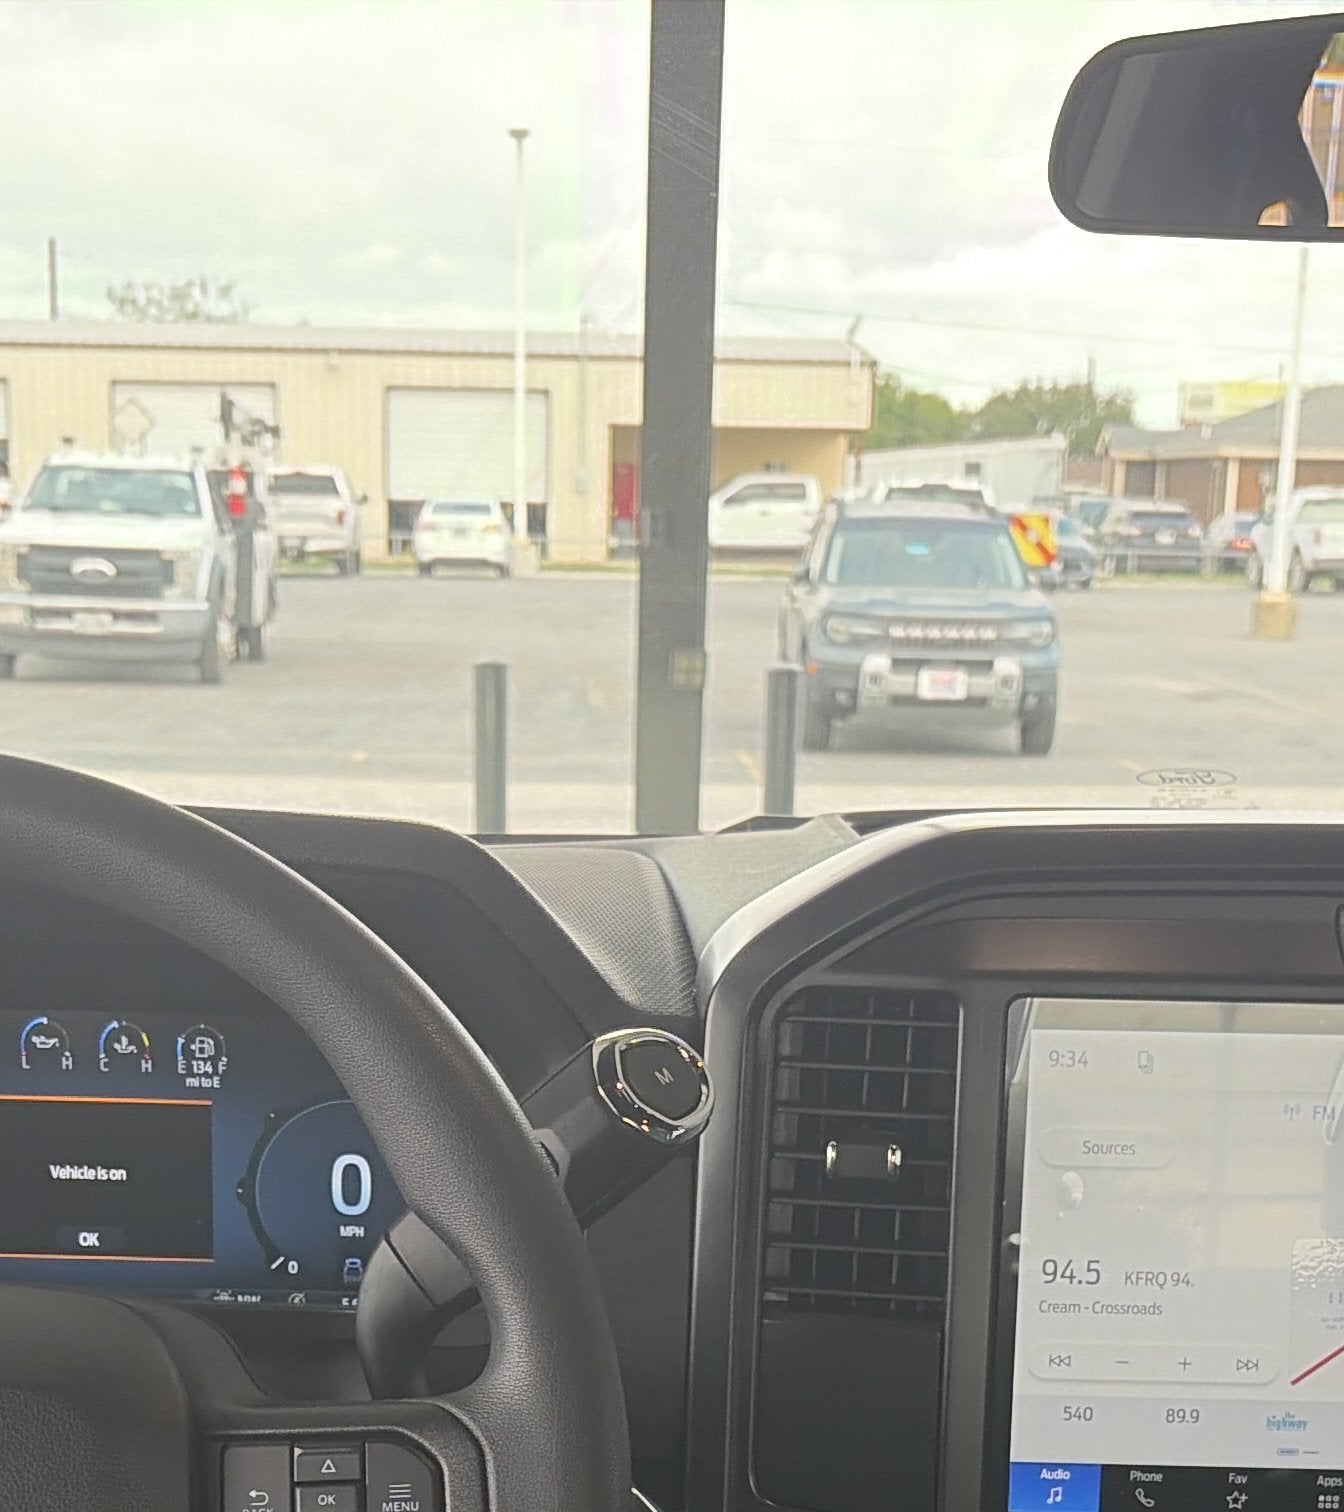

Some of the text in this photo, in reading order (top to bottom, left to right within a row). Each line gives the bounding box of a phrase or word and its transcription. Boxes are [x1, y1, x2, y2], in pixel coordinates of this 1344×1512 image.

[22, 1056, 31, 1070] L
[61, 1056, 73, 1070] H
[99, 1059, 110, 1072] C
[1048, 1049, 1089, 1068] 9:34
[141, 1060, 153, 1073] H
[177, 1060, 187, 1074] E
[192, 1060, 213, 1074] 134
[654, 1067, 675, 1086] M
[1312, 1104, 1336, 1122] FM
[1082, 1140, 1136, 1156] Sources
[49, 1164, 127, 1181] Vehicle is on
[331, 1154, 372, 1216] 0
[339, 1225, 365, 1237] MPH
[78, 1231, 100, 1247] OK
[287, 1260, 299, 1274] 0
[1041, 1258, 1101, 1285] 94.5
[1124, 1271, 1168, 1289] KFRQ
[1038, 1300, 1081, 1314] Cream
[1091, 1301, 1163, 1316] Crossroads
[1062, 1406, 1094, 1422] 540
[1165, 1408, 1200, 1424] 89.9
[1266, 1415, 1309, 1431] highway
[1040, 1468, 1071, 1480] Audio
[1129, 1470, 1164, 1482] Phone
[1228, 1473, 1248, 1484] Fav
[1316, 1475, 1343, 1488] Apps
[317, 1494, 336, 1505] OK
[382, 1501, 420, 1512] MENU
